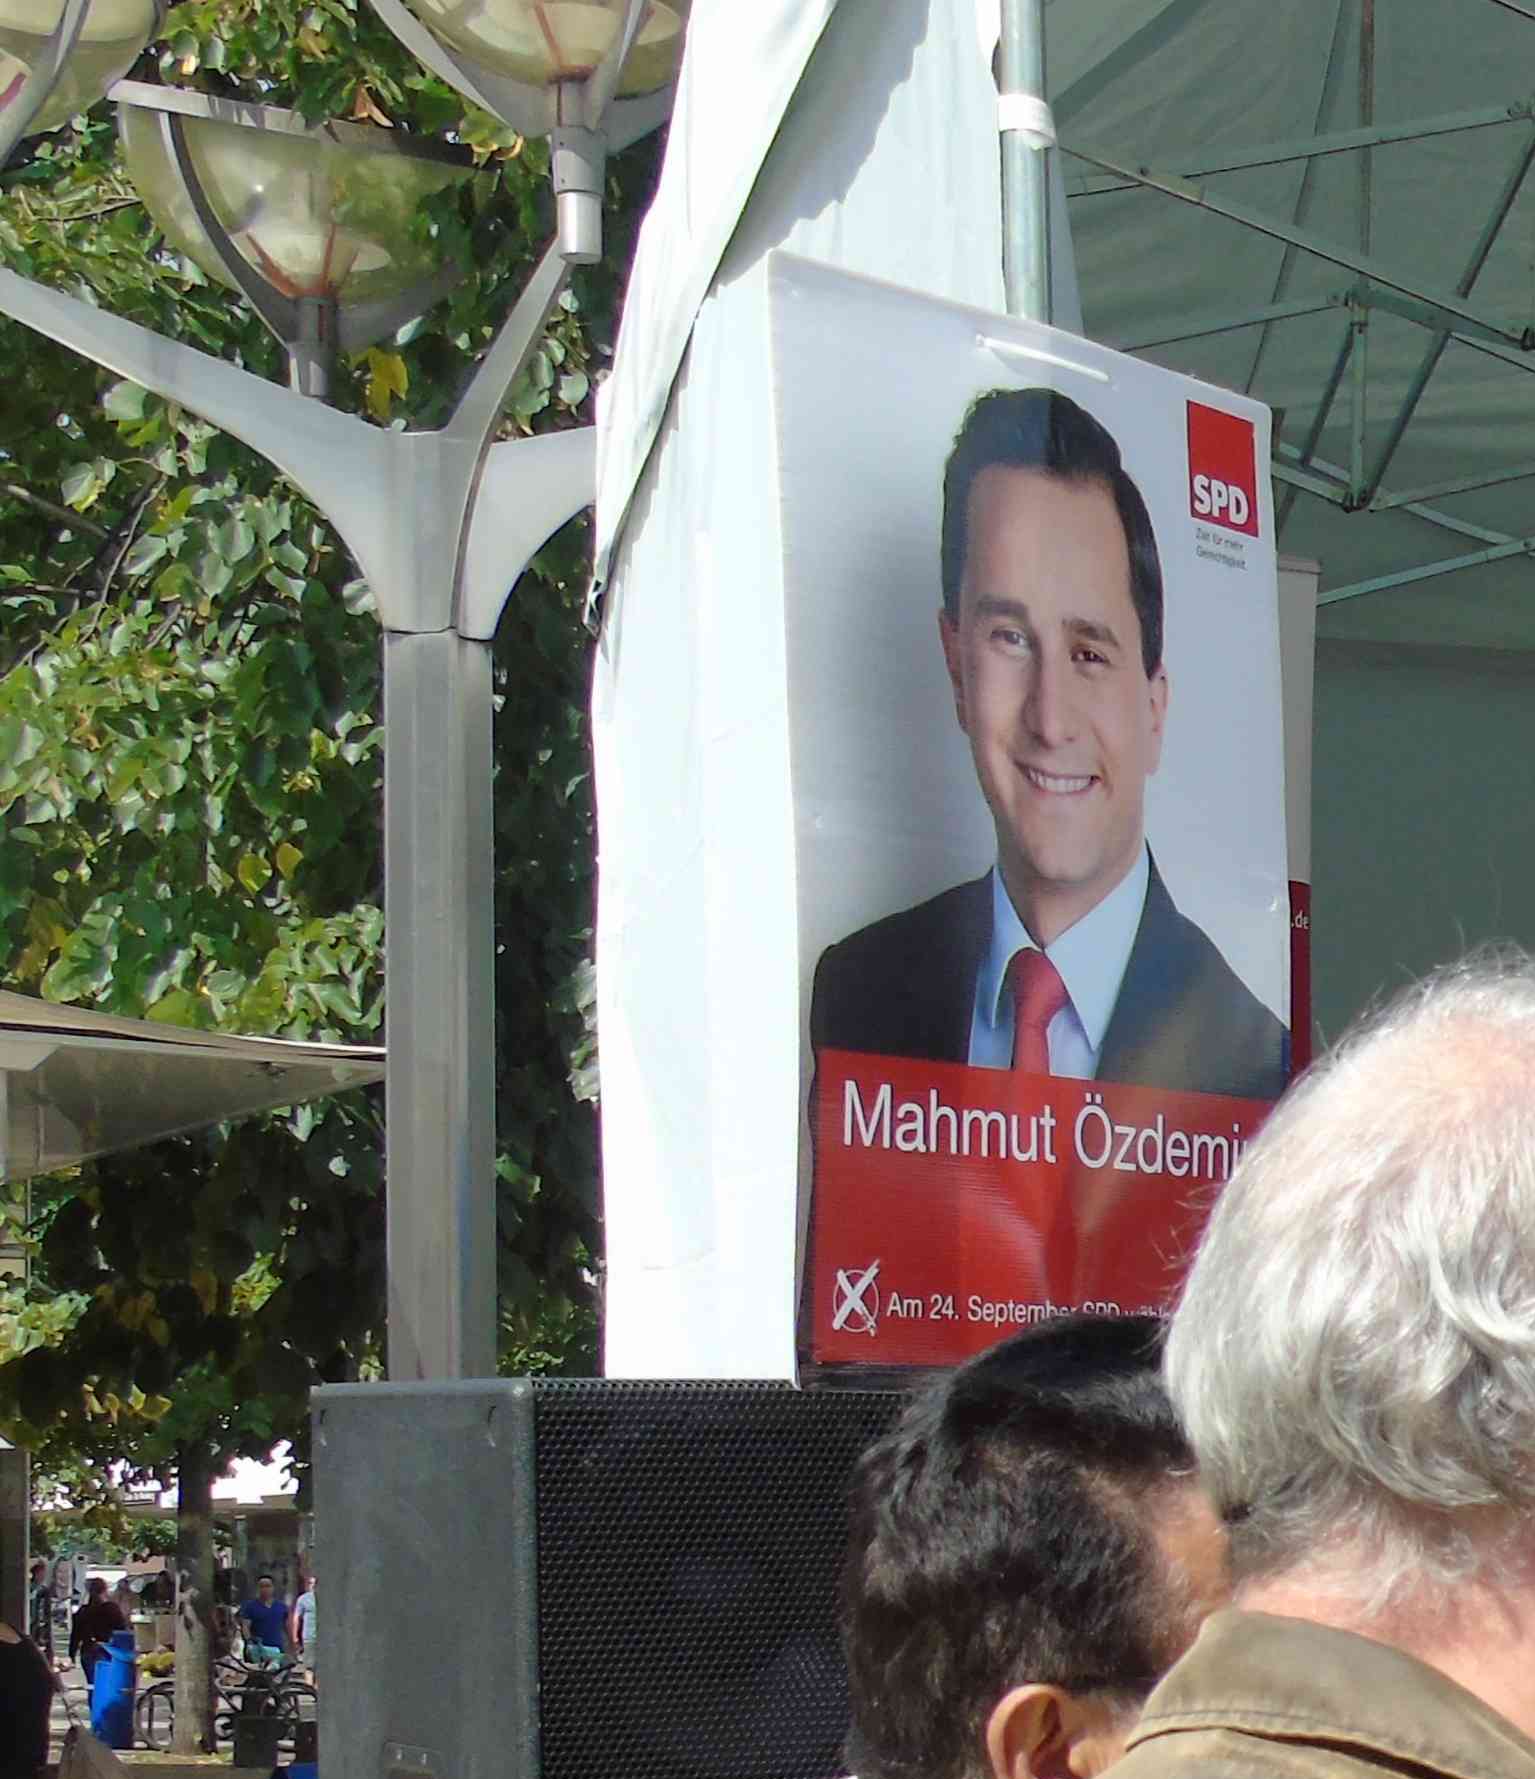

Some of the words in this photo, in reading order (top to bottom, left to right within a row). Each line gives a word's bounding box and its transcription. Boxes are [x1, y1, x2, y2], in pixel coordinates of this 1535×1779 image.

[1193, 474, 1249, 525] SPD
[843, 1079, 1057, 1164] Mahmut
[1074, 1092, 1250, 1180] Özdemi
[886, 1292, 922, 1319] Am
[929, 1294, 960, 1321] 24.
